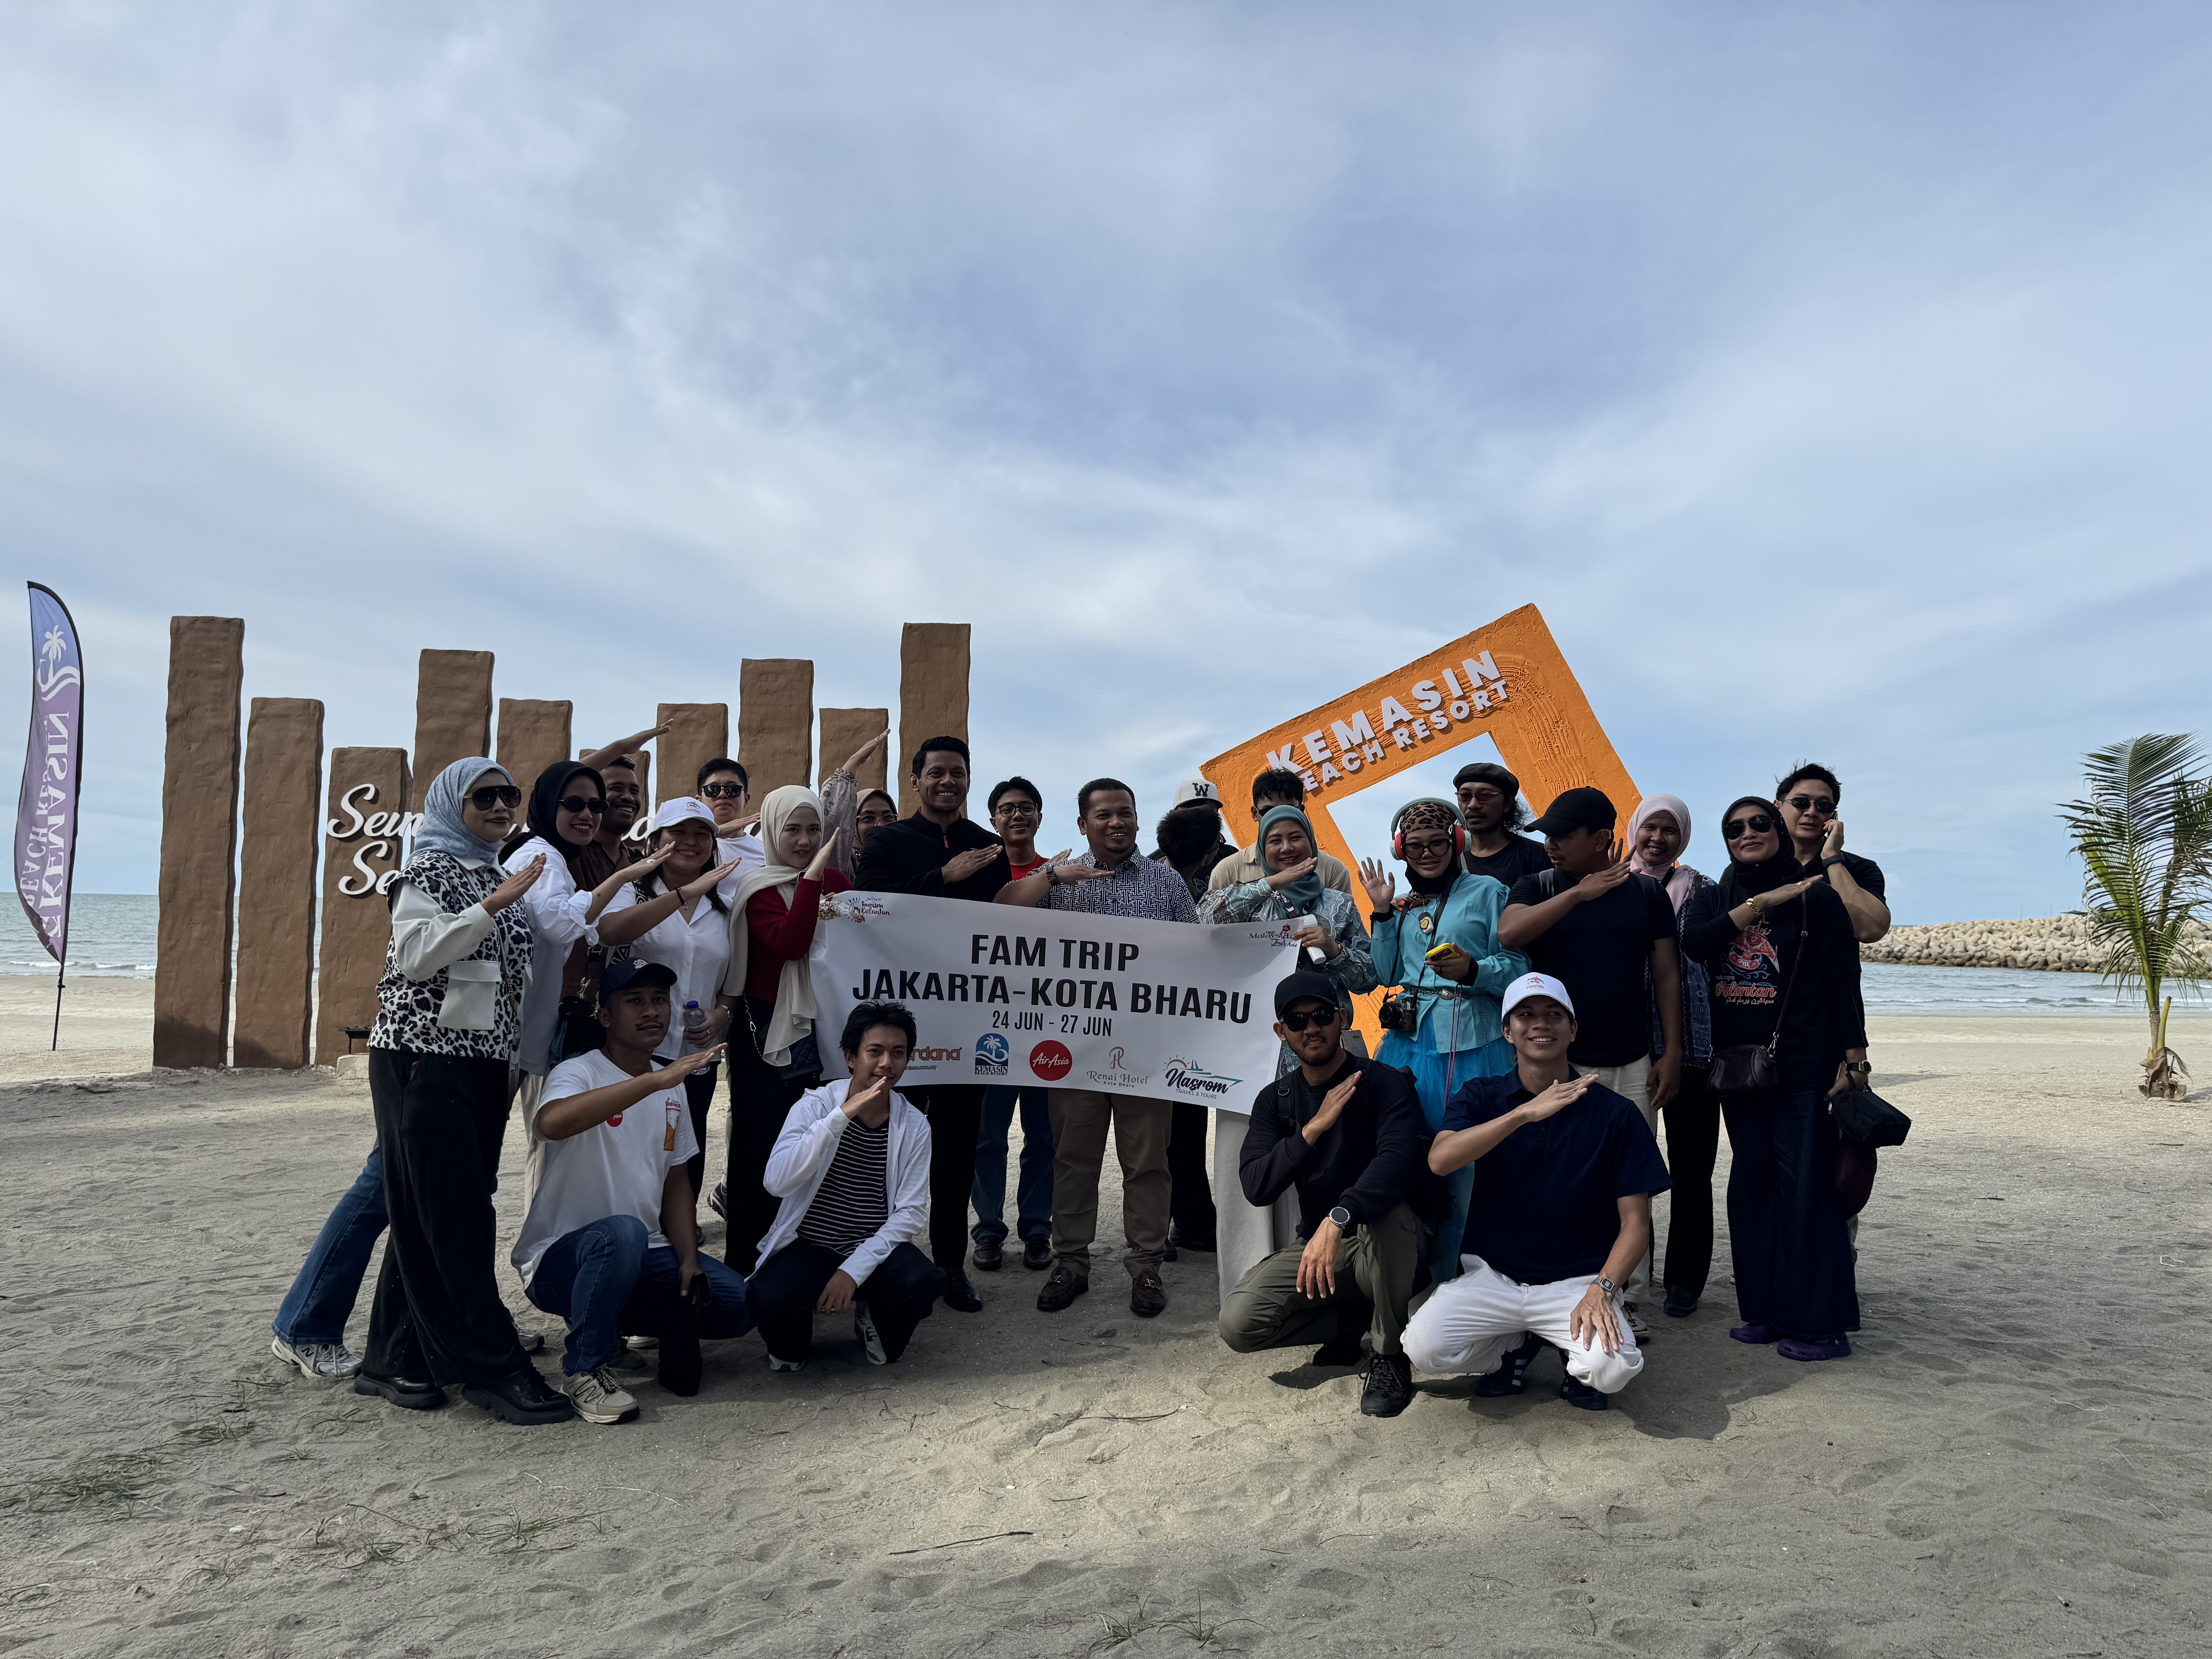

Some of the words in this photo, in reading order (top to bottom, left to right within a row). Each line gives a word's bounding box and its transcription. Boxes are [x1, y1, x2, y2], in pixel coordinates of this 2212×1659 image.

[1266, 650, 1501, 773] KEMASIN
[1298, 739, 1384, 792] EACH
[1392, 680, 1509, 749] RESORT
[1192, 782, 1210, 797] W
[971, 934, 1046, 967] FAM
[1059, 939, 1139, 971] TRIP
[1715, 981, 1777, 998] Kelantan
[1130, 983, 1252, 1024] BHARU
[992, 1010, 1010, 1029] 24
[1014, 1012, 1043, 1031] JUN
[1061, 1014, 1079, 1034] 27
[1083, 1016, 1112, 1037] JUN
[911, 1046, 960, 1061] rdana
[1087, 1070, 1116, 1083] Renai
[1120, 1074, 1149, 1084] Hotel
[1165, 1068, 1229, 1094] Nasrom
